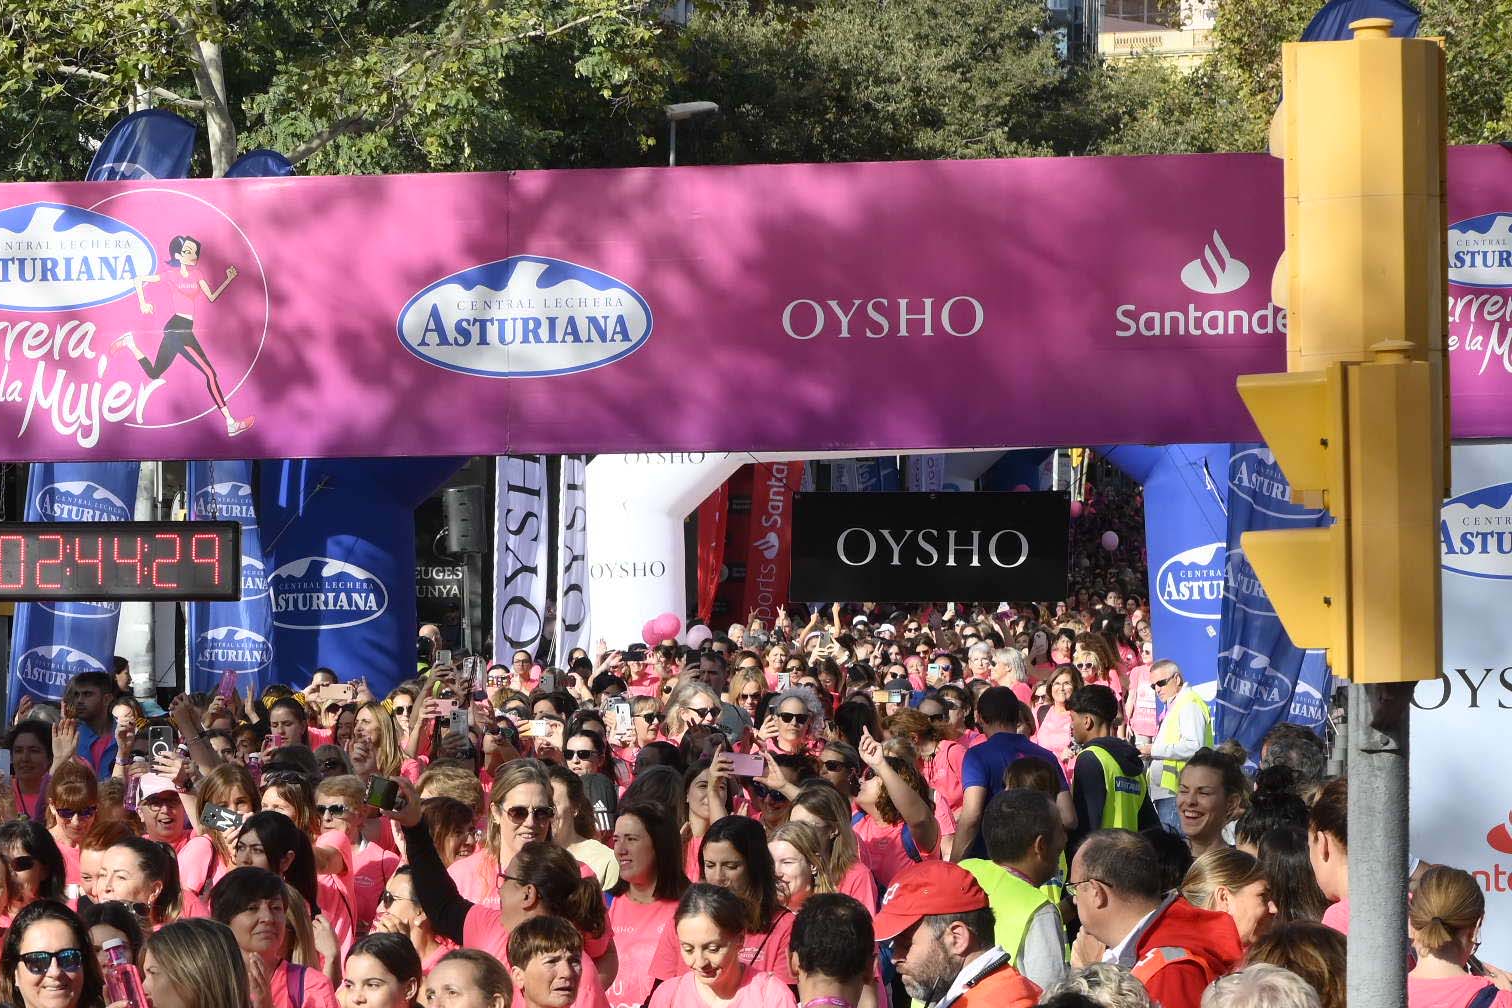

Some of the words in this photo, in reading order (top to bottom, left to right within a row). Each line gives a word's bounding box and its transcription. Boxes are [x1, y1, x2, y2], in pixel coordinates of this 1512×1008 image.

[61, 239, 132, 249] LECHERA
[1456, 239, 1506, 247] CENTRAL
[1448, 250, 1512, 268] STUR
[457, 299, 534, 311] CENTRAL
[544, 297, 624, 309] LECHERA
[417, 303, 632, 347] ASTURIANA
[782, 296, 984, 339] OYSHO
[1116, 302, 1288, 338] Santande
[18, 355, 166, 448] Mujer
[761, 463, 787, 528] Santa
[837, 527, 1029, 568] OYSHO
[590, 561, 666, 580] OYSHO
[1180, 570, 1222, 578] CENTRA
[325, 581, 374, 589] LECHERA
